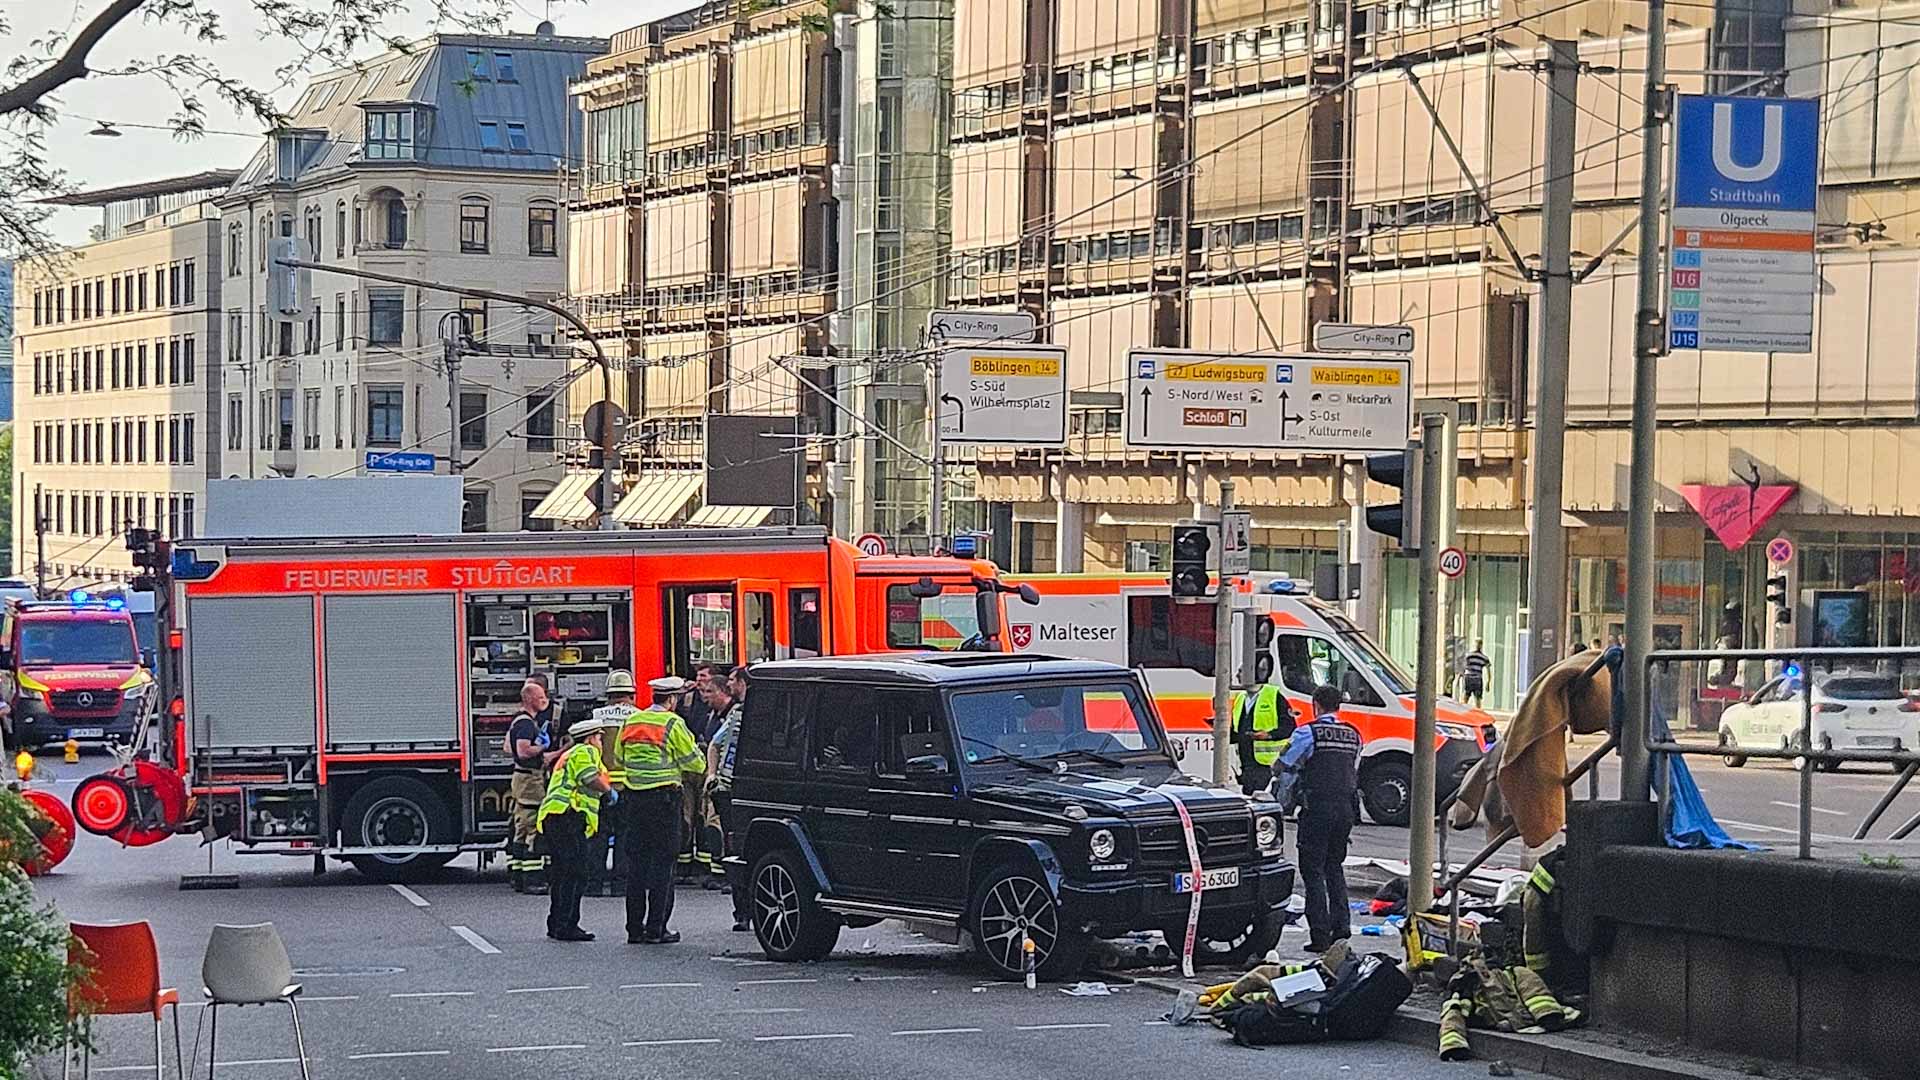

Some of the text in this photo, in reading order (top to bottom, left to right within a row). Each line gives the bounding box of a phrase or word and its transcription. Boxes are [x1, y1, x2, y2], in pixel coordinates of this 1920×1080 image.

[1712, 103, 1783, 182] U
[1710, 187, 1781, 203] Stadtbahn
[1720, 212, 1769, 229] Olgaeck
[1674, 313, 1695, 325] U12
[954, 320, 998, 332] City-Ring
[1353, 333, 1395, 345] City-Ring
[1671, 334, 1696, 346] U15
[973, 361, 1030, 374] Böblingen
[1192, 371, 1264, 381] Ludwigsburg
[1314, 371, 1373, 383] Waiblingen
[970, 380, 1005, 391] S-Süd
[970, 396, 1050, 410] Wilhelmsplatz
[1346, 393, 1392, 405] NeckarPark
[1185, 412, 1224, 423] Schloß
[1310, 411, 1340, 421] S-Ost
[1309, 426, 1371, 437] Kulturmeile
[384, 458, 414, 467] City-Ring
[864, 543, 880, 556] 40
[1443, 555, 1460, 570] 40
[284, 565, 576, 588] FEUERWEHR STUTTGART
[1040, 623, 1117, 640] Malteser
[1194, 738, 1214, 751] 11
[1208, 871, 1237, 887] 6300
